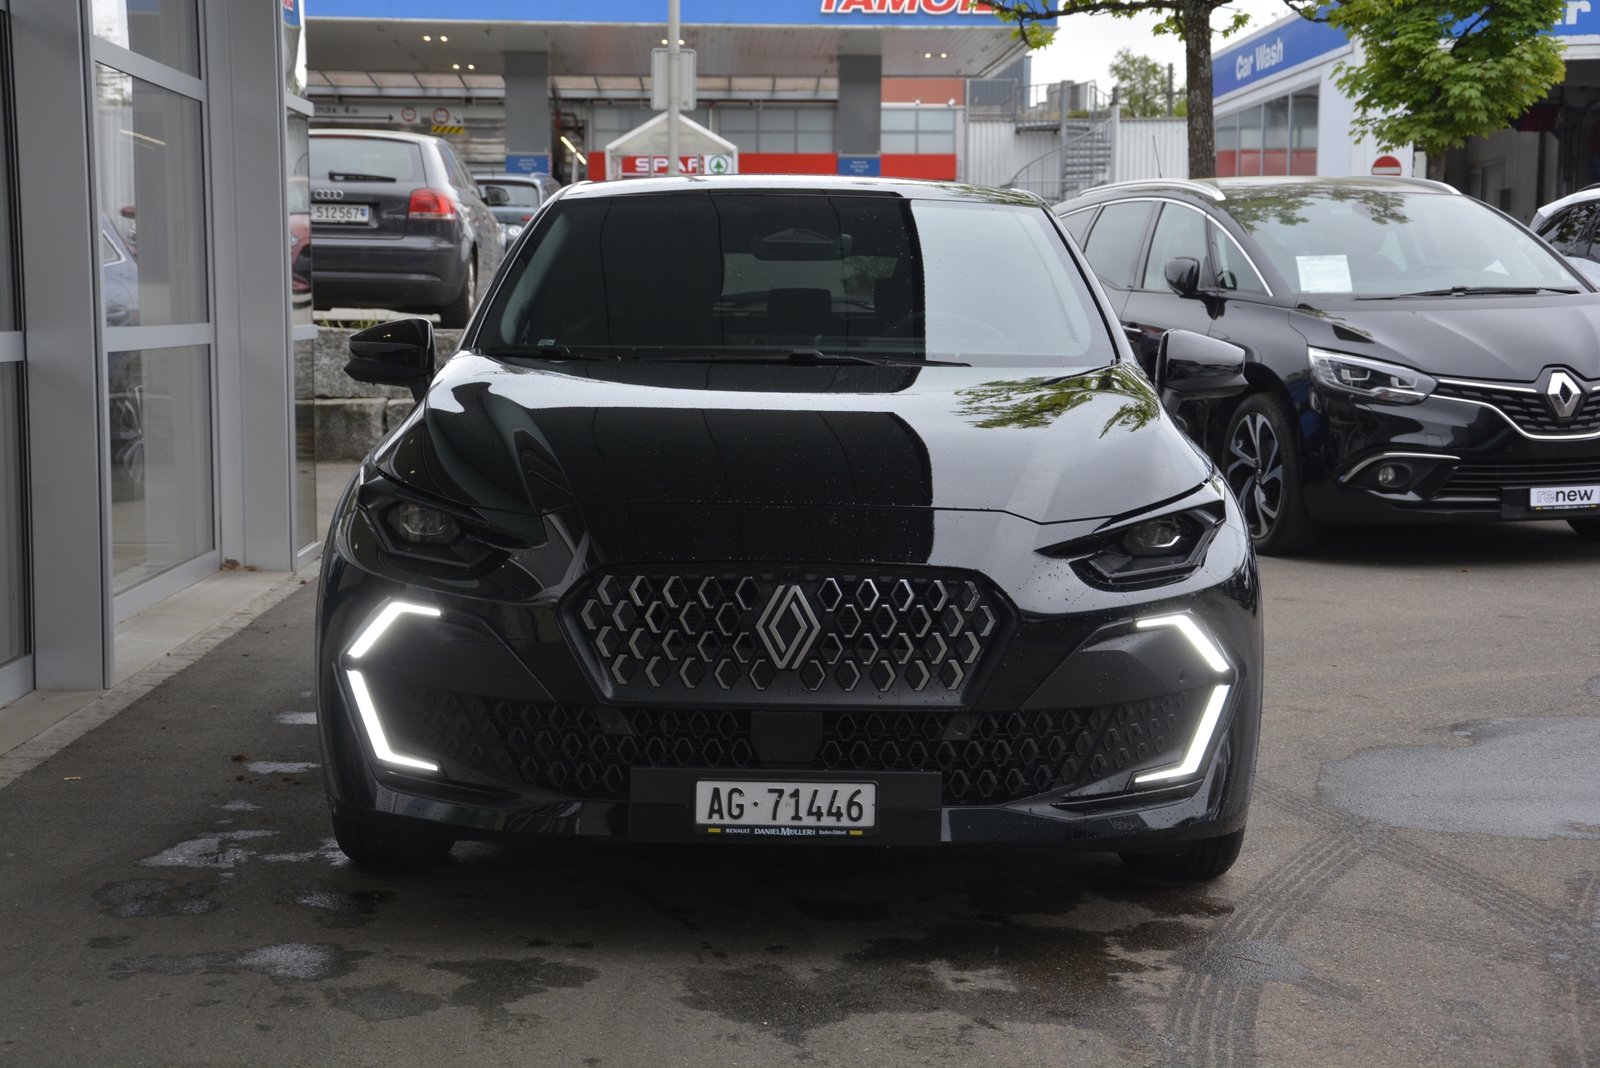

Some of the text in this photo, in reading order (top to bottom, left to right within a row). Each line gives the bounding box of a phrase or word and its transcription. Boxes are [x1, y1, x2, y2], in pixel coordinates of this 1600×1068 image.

[1236, 37, 1283, 80] Car Wash
[1536, 489, 1594, 504] renew
